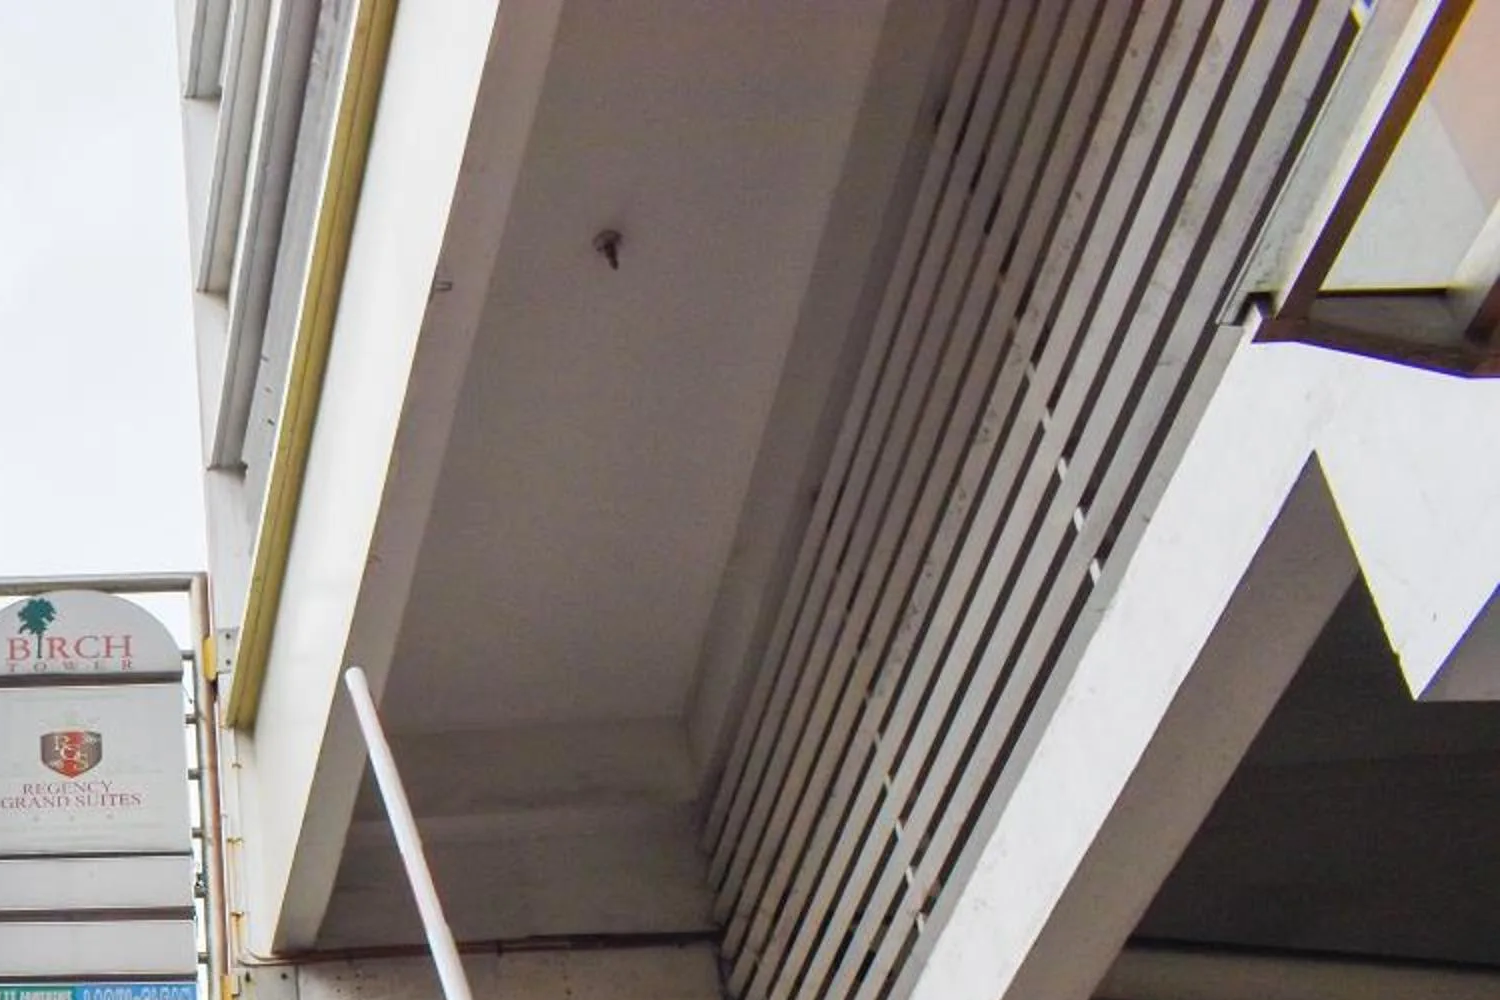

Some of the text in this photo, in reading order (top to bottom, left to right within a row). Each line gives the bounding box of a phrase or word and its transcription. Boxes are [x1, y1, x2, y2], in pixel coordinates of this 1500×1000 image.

[7, 635, 133, 661] BIRCH
[23, 780, 113, 795] REGENCY
[1, 794, 142, 809] GRAND SUITES
